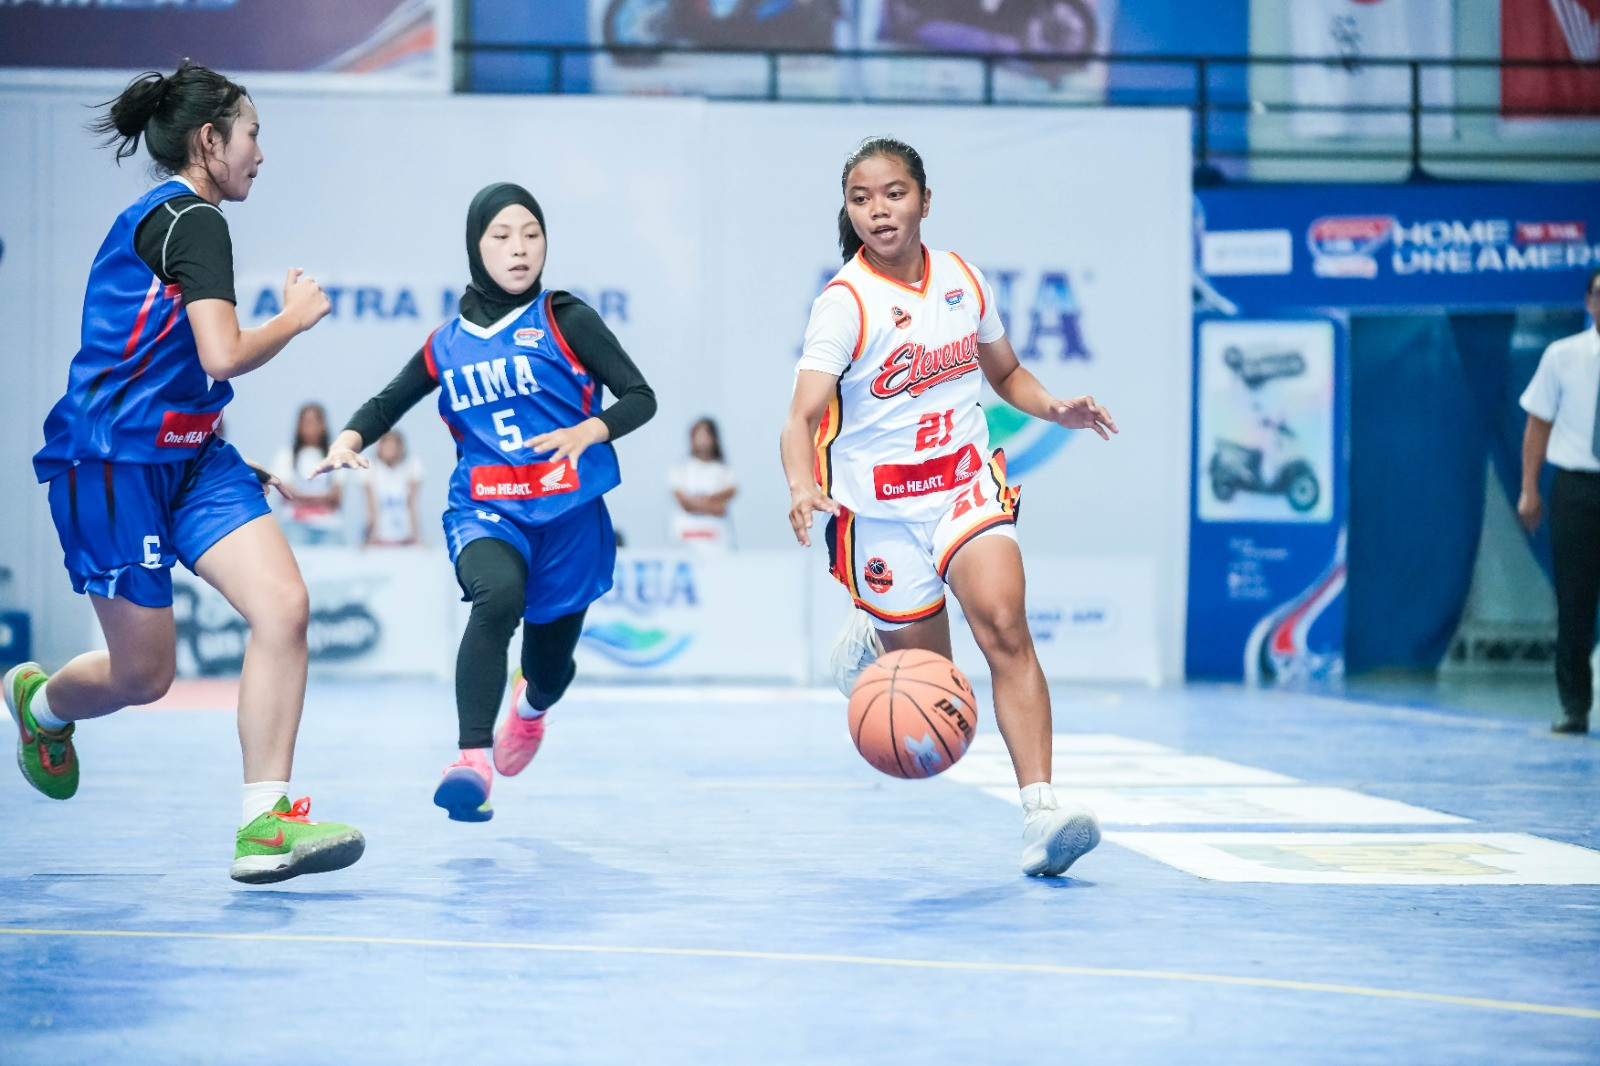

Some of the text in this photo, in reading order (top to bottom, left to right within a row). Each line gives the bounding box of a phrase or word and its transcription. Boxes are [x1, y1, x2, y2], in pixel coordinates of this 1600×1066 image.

[1393, 219, 1509, 248] HOME
[253, 286, 419, 319] ATRA
[443, 355, 542, 412] LIMA
[163, 431, 184, 443] One
[491, 408, 523, 452] 5
[914, 409, 954, 452] 21
[475, 483, 497, 496] One
[882, 483, 904, 496] One
